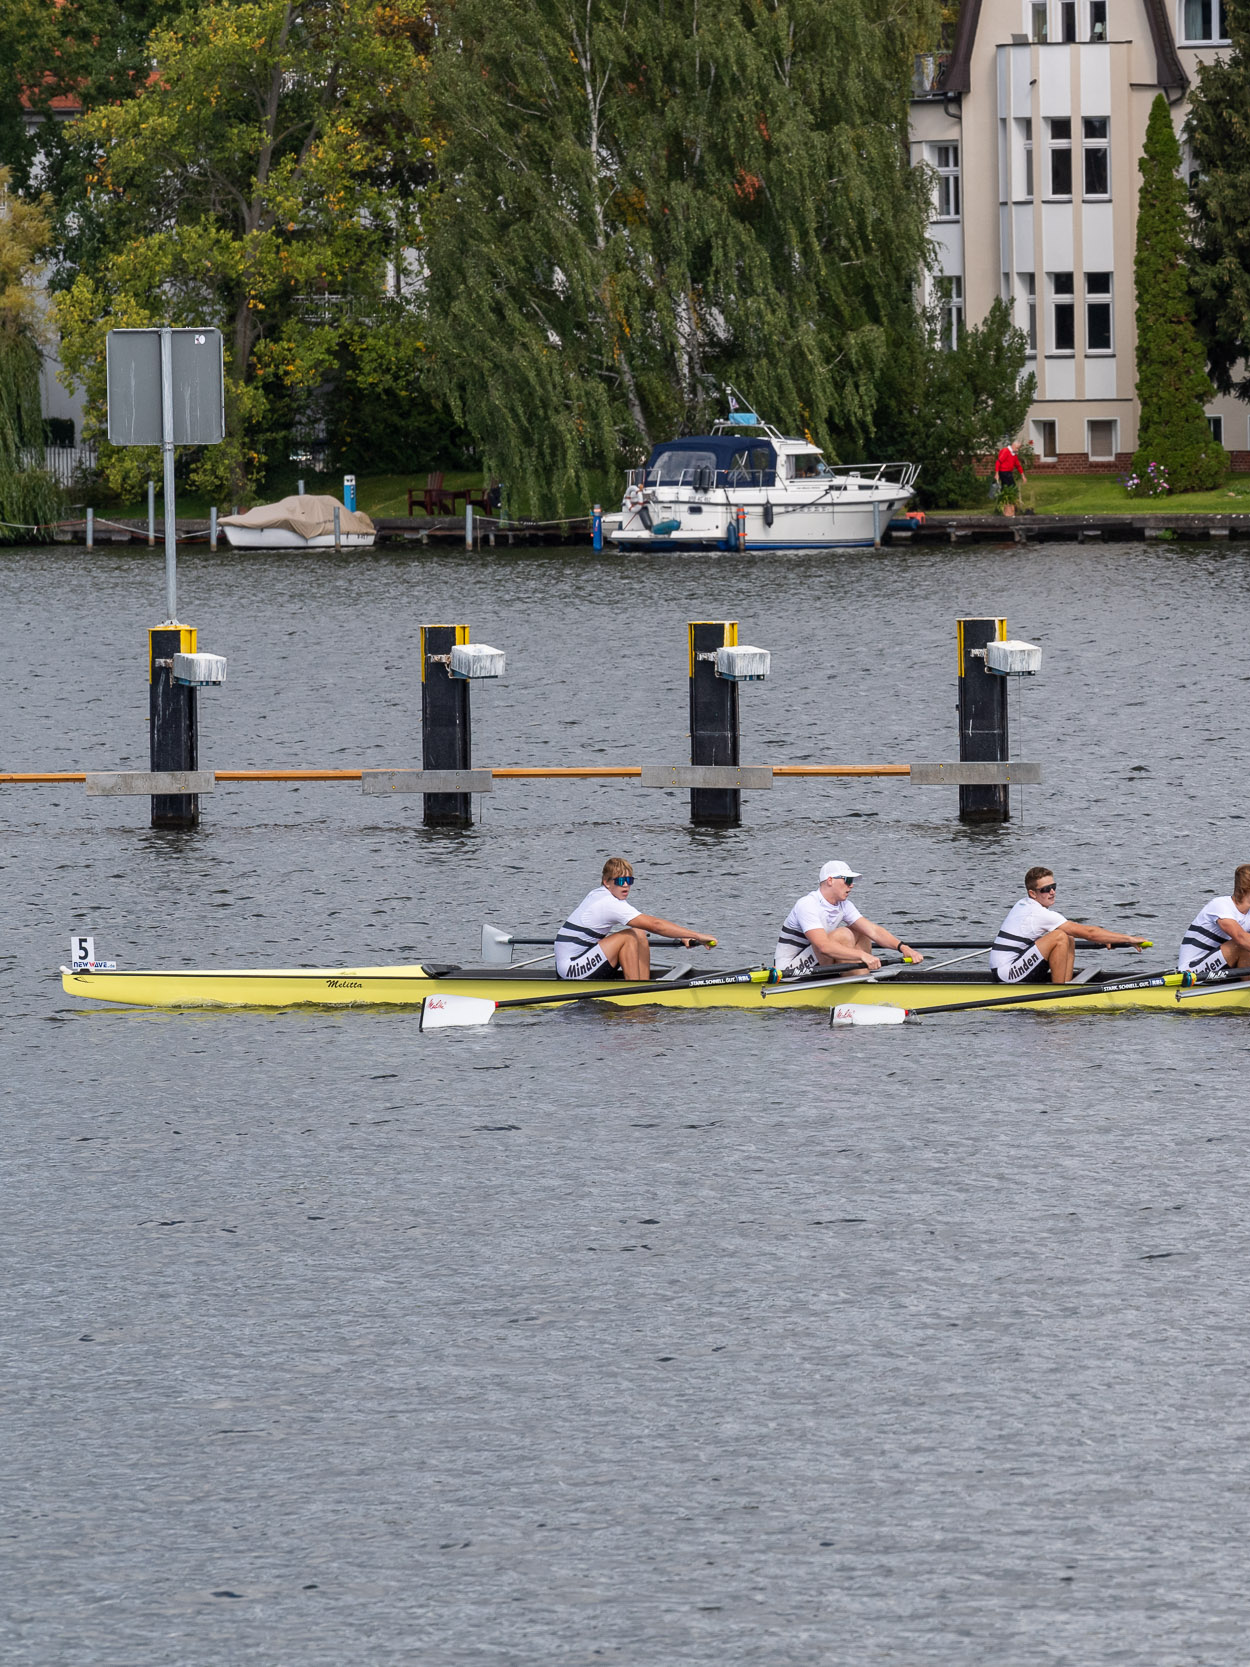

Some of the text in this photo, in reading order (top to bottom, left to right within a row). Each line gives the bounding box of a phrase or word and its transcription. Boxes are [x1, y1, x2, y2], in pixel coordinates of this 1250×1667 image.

[78, 937, 89, 960] 5
[566, 953, 602, 978] Minden
[1008, 952, 1039, 980] Minden
[326, 979, 363, 989] Melitta
